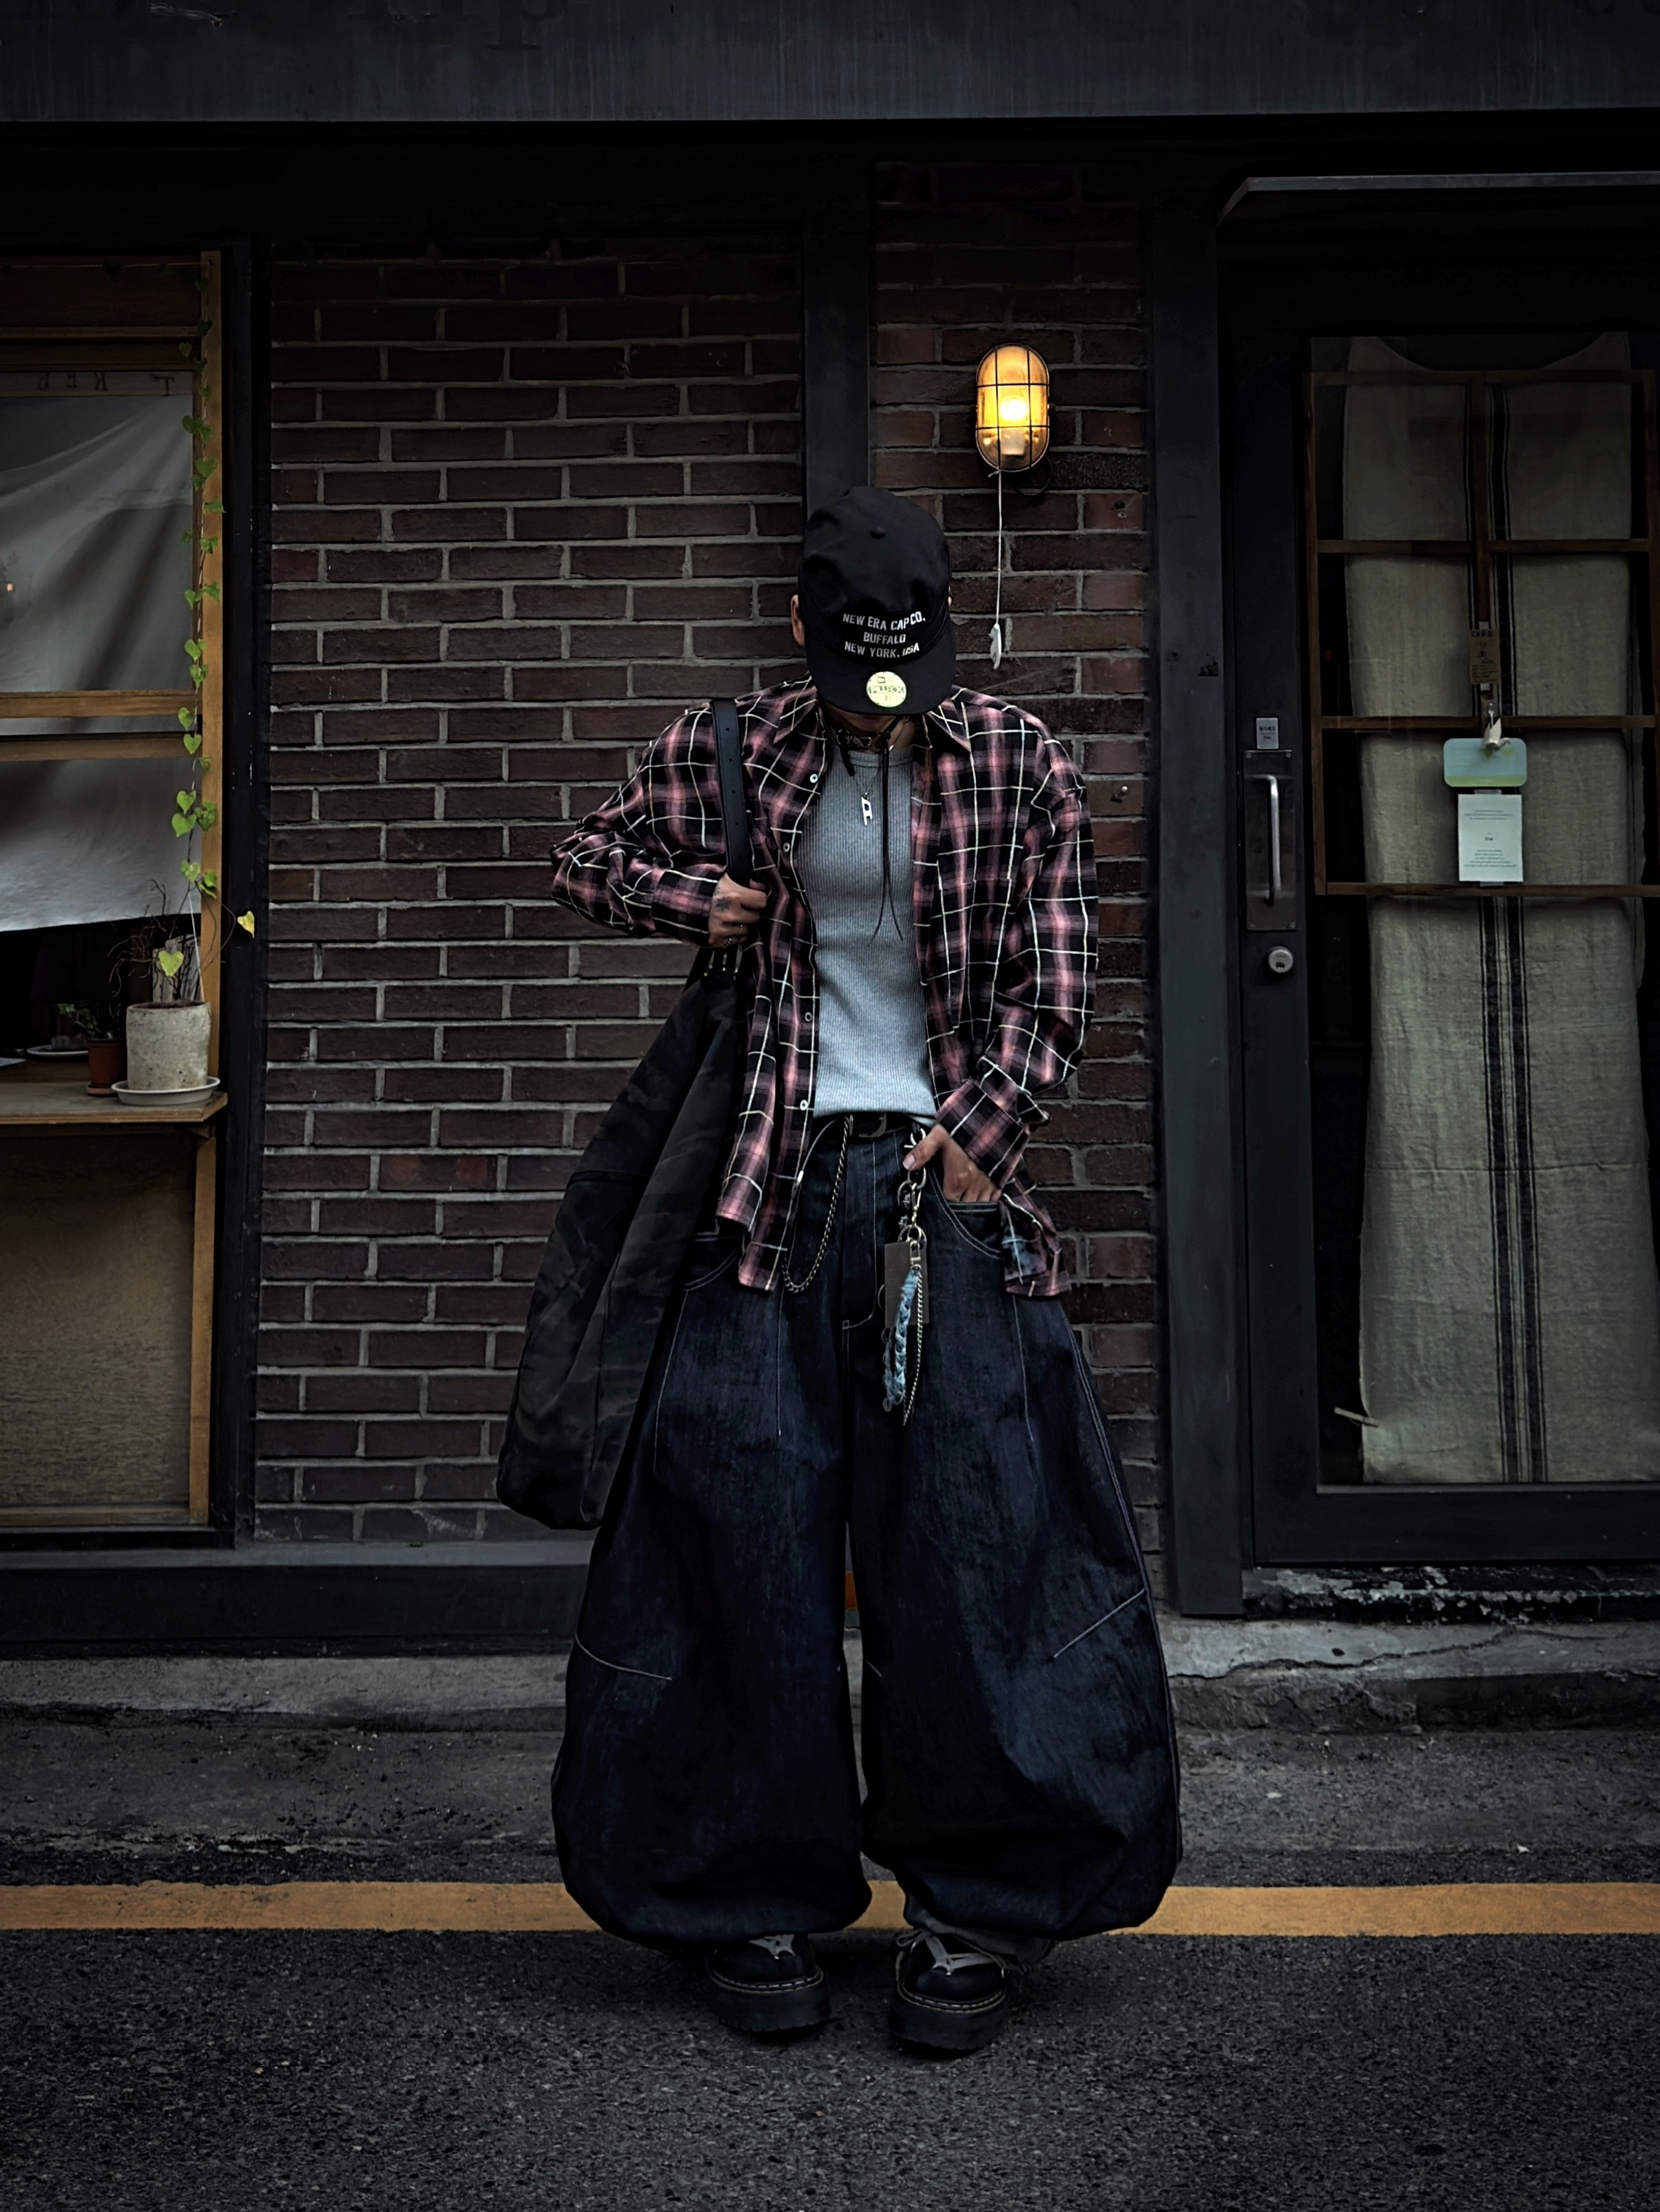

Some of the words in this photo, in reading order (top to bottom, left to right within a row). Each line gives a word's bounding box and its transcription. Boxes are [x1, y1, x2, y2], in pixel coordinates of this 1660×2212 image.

[842, 612, 865, 626] NEW
[867, 616, 886, 632] ERA
[862, 632, 906, 645] BUFFALO
[844, 640, 866, 655] NEW
[902, 642, 920, 656] USA
